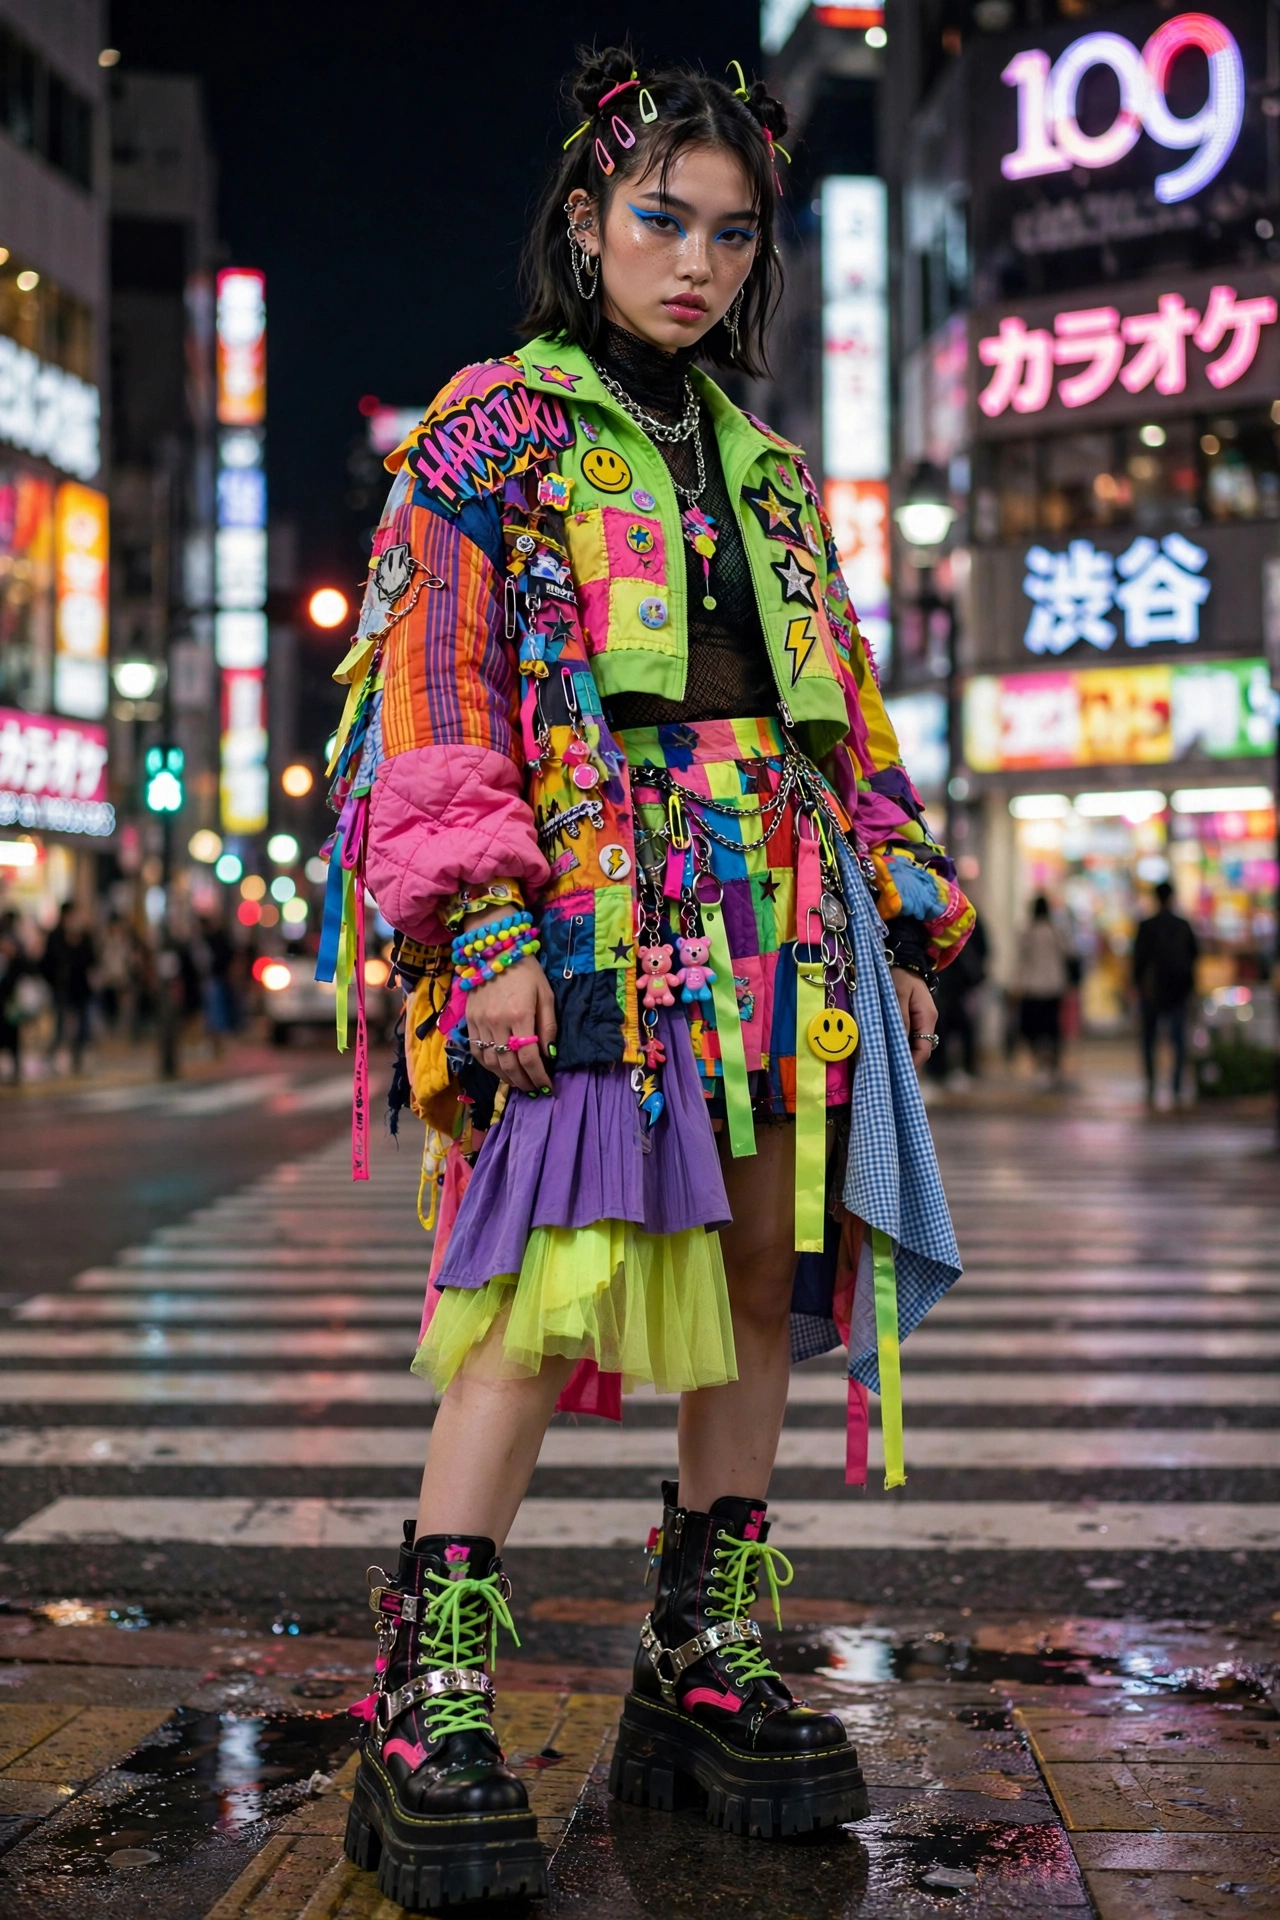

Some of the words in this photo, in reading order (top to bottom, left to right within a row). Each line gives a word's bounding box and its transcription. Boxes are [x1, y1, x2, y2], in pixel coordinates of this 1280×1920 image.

[1000, 12, 1245, 204] 109
[978, 285, 1278, 417] カラオケ
[416, 386, 576, 501] HARAJUKU
[1022, 532, 1211, 655] 渋谷
